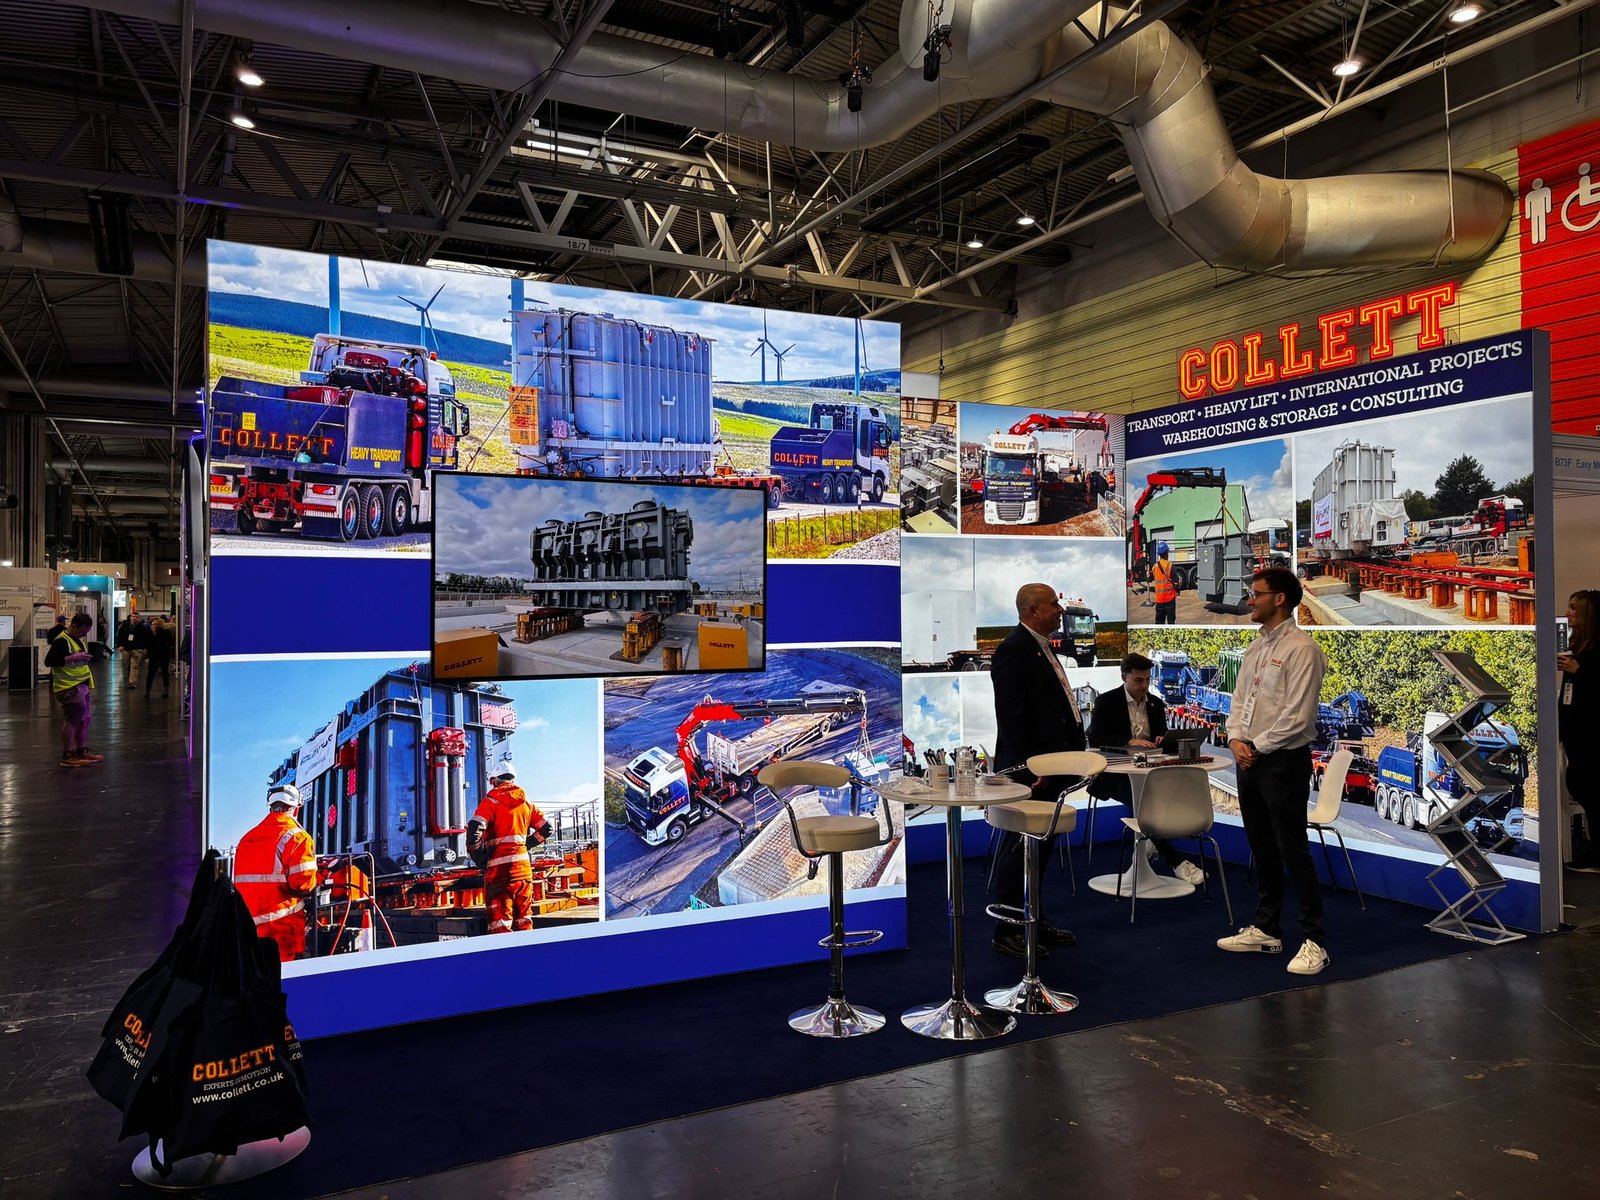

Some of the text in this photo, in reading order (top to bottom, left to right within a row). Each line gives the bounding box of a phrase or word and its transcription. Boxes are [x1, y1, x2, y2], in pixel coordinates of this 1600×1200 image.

[567, 240, 587, 250] 18/7
[1179, 282, 1455, 399] COLLETT
[1127, 340, 1523, 433] TRANSPORT HEAVY LIFT INTERNATIONAL PROJECTS
[1162, 378, 1465, 446] WAREHOUSING & STORAGE CONSULTING
[220, 428, 335, 456] COLLETT
[351, 446, 401, 462] HEAVY TRANSPORT
[993, 441, 1027, 450] COLLETT
[774, 452, 818, 465] COLLETT
[444, 656, 484, 671] COLLETT
[659, 795, 686, 815] COLLETT
[192, 1043, 276, 1082] COLLETT
[192, 1071, 284, 1104] www.collett.co.uk
[203, 1079, 235, 1091] EXPERTS
[240, 1066, 271, 1082] MOTION
